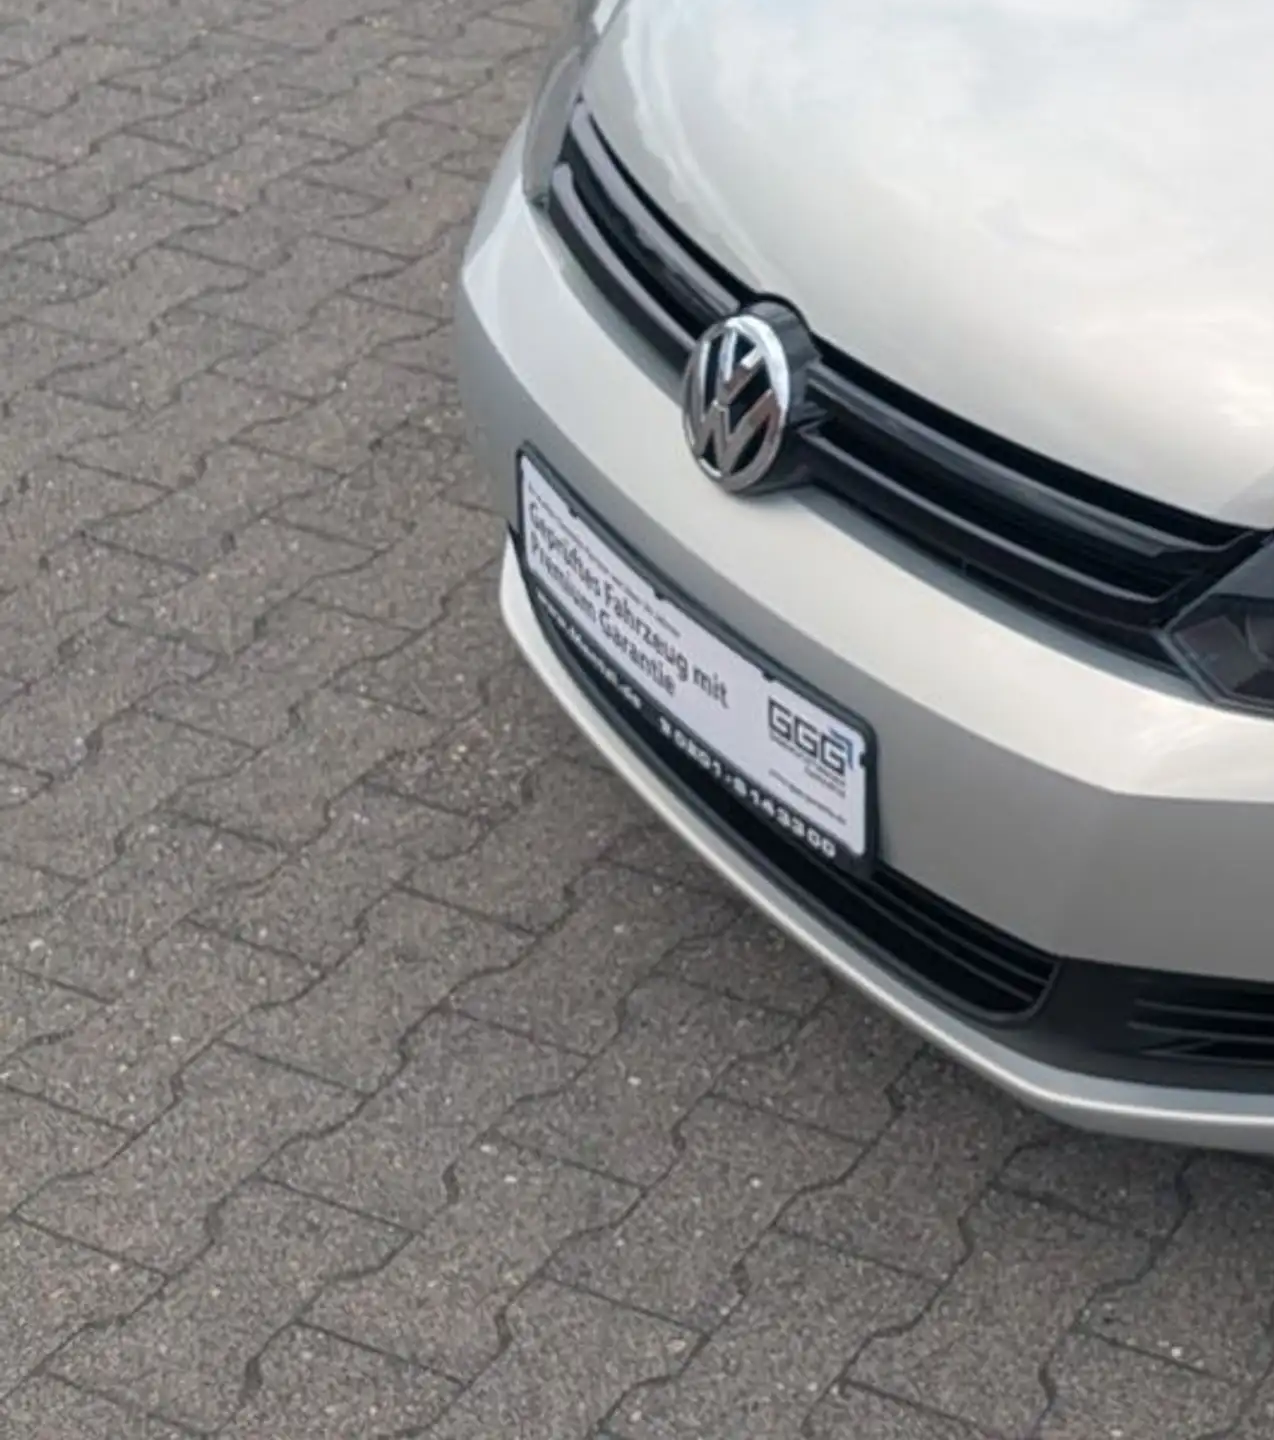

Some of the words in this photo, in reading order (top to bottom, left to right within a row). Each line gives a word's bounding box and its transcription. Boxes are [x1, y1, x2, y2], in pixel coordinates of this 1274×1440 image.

[530, 529, 597, 624] Premium
[598, 608, 677, 699] Garantie
[604, 579, 688, 681] Fahrzeug
[692, 665, 730, 709] mit
[768, 696, 846, 775] GGG
